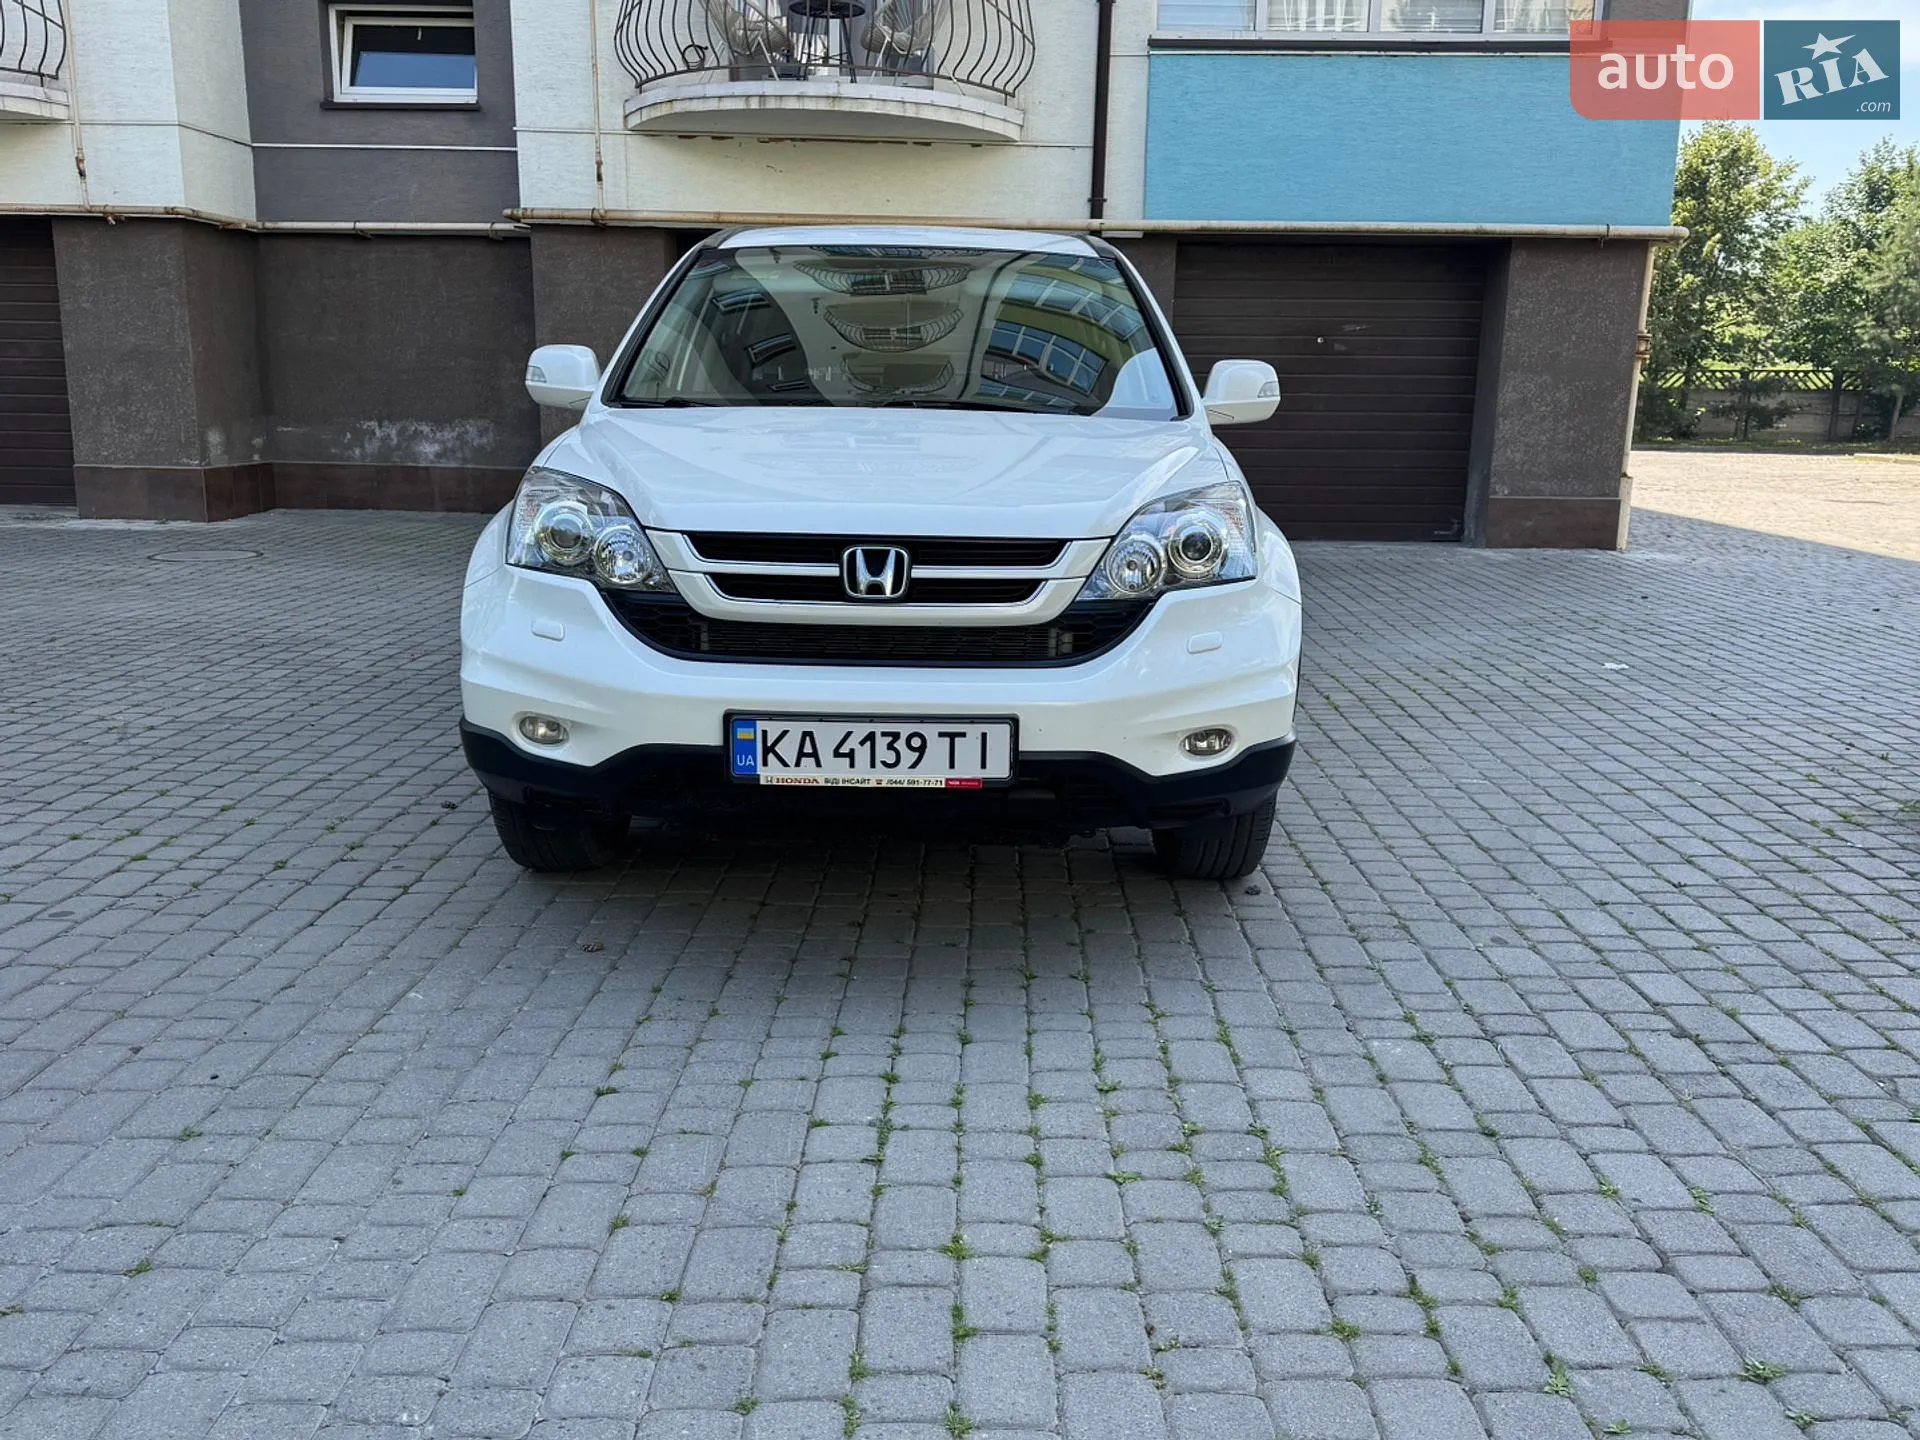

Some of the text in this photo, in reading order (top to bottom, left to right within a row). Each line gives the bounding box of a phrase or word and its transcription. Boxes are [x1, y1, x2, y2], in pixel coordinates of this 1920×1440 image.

[761, 729, 988, 770] KA 4139 TI
[737, 754, 755, 766] UA
[775, 776, 820, 784] HONDA
